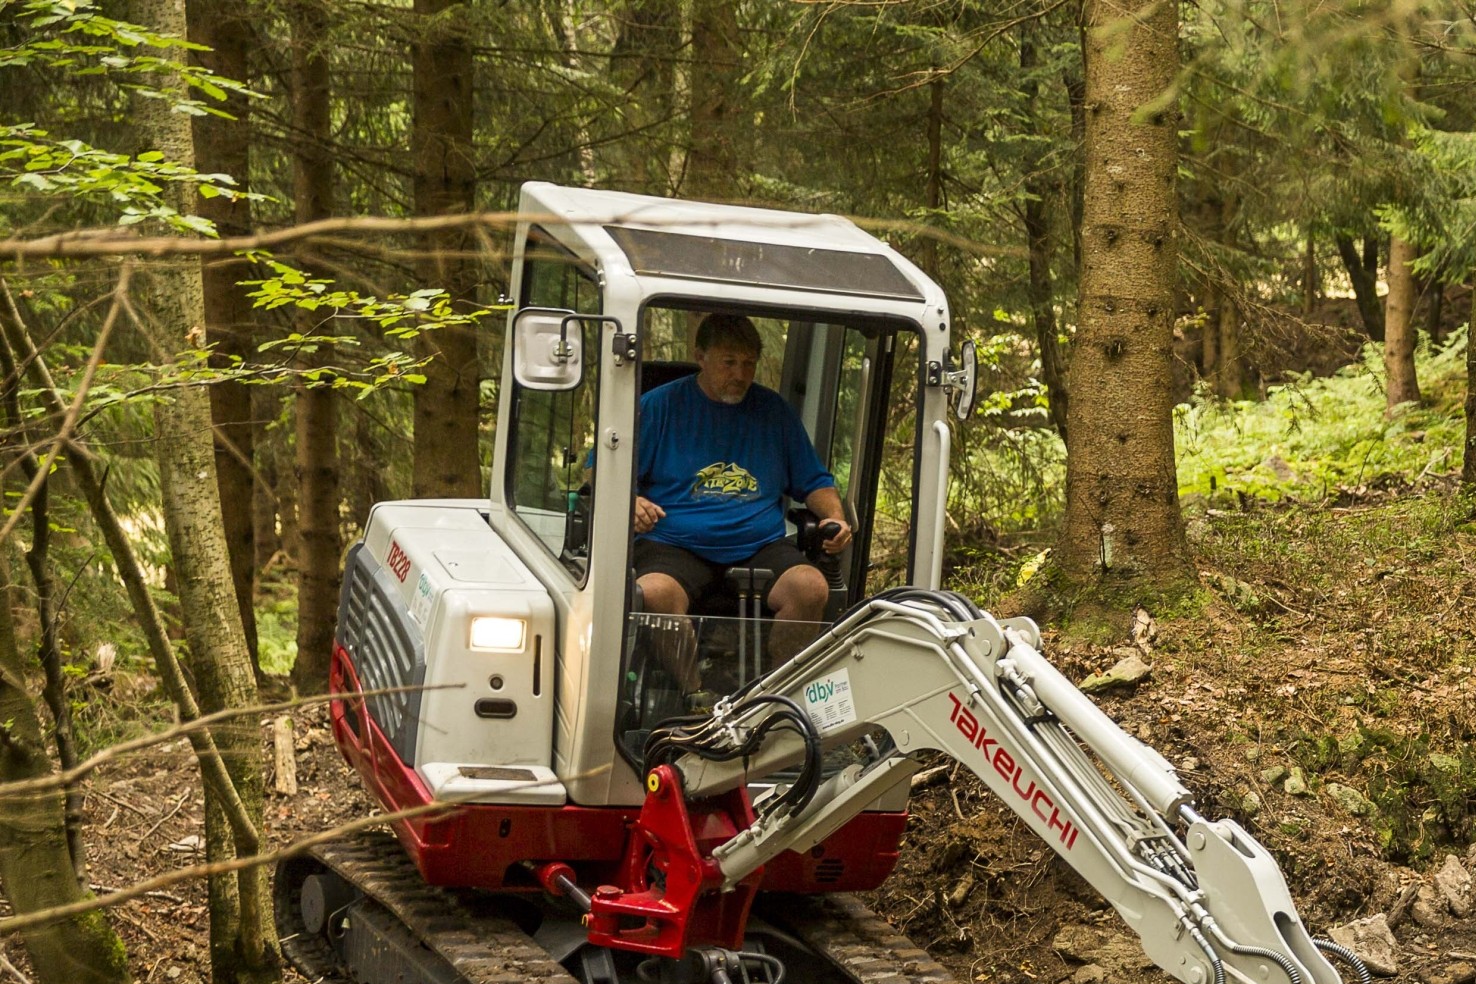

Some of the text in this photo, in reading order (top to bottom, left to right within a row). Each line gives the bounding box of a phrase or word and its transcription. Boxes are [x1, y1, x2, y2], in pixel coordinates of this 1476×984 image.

[387, 541, 411, 583] TB228
[806, 679, 834, 703] dbv
[948, 691, 1079, 851] TAKEUCHI
